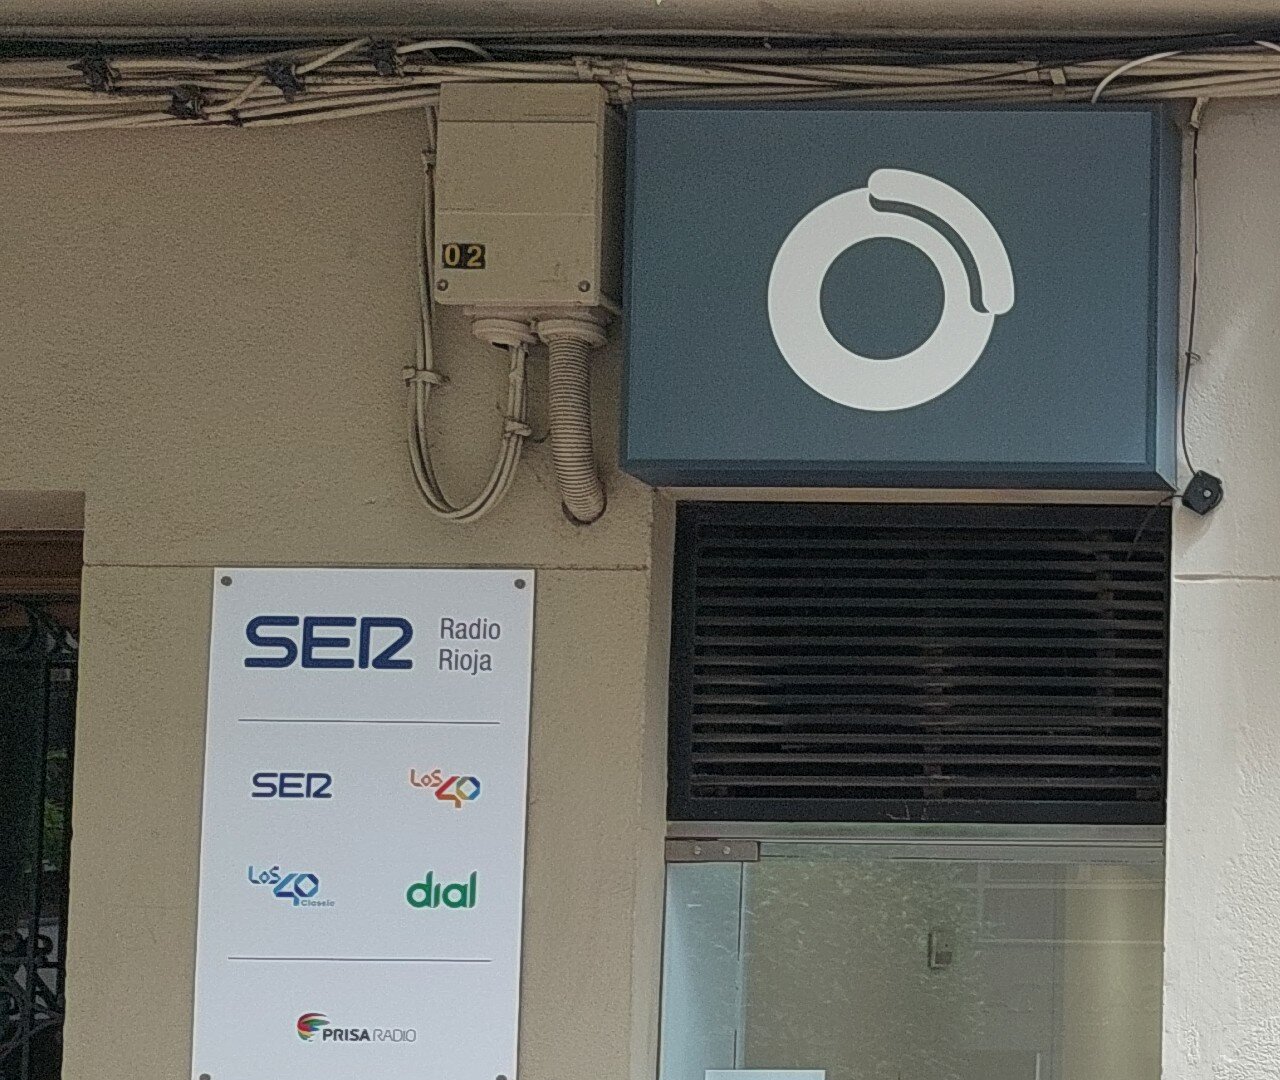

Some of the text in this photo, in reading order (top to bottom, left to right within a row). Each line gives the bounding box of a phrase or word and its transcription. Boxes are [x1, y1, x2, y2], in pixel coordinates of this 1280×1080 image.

[444, 243, 484, 268] 02
[439, 617, 501, 640] Radio
[244, 615, 414, 670] SER
[438, 648, 493, 676] Rioja
[251, 772, 333, 799] SER
[434, 775, 482, 809] 40
[272, 873, 320, 907] 40
[300, 899, 336, 907] Classic
[406, 870, 478, 909] dial
[322, 1028, 417, 1042] PRISA RADIO
